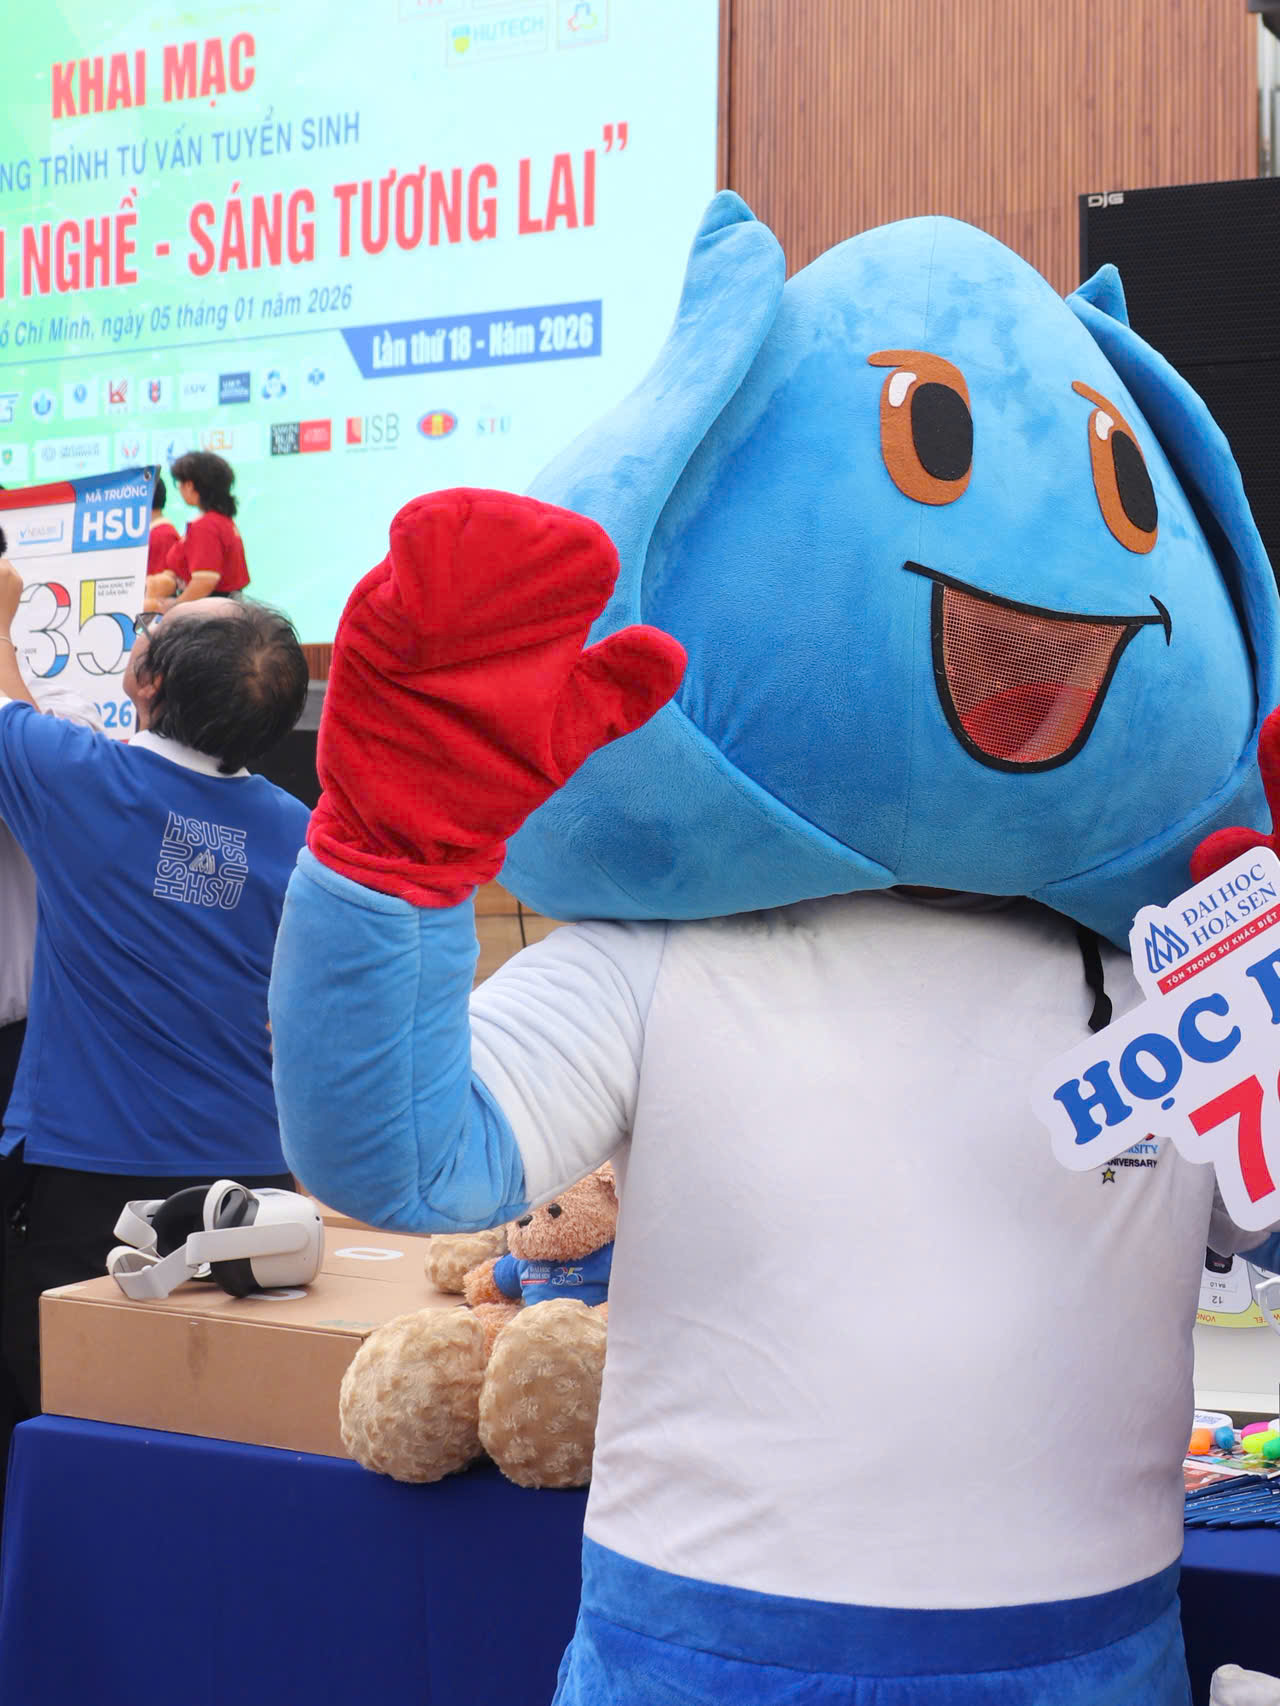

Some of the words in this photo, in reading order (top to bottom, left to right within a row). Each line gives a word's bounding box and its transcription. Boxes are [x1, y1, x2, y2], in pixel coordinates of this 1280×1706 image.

[52, 49, 146, 119] KHAI
[163, 31, 256, 108] MẠC
[40, 145, 108, 186] TRÌNH
[117, 137, 148, 176] TƯ
[156, 122, 203, 171] VẤN
[212, 105, 292, 164] TUYỂN
[301, 111, 360, 151] SINH
[22, 187, 138, 296] NGHỀ
[188, 181, 316, 277] SÁNG
[333, 164, 498, 257] TƯƠNG
[103, 312, 144, 342] ngày
[151, 306, 171, 331] 05
[177, 302, 228, 331] tháng
[234, 296, 255, 322] 01
[261, 291, 302, 319] năm
[308, 284, 352, 314] 2026
[448, 325, 472, 361] 18
[489, 320, 536, 357] Năm
[540, 312, 593, 352] 2026
[366, 412, 400, 445] ISB
[82, 506, 147, 543] HSU
[164, 811, 221, 850] HSU
[184, 873, 243, 910] HSU
[1192, 909, 1239, 946] HOA
[1237, 882, 1277, 917] SEN
[1166, 971, 1185, 987] TÔN
[1186, 953, 1217, 974] TRỌNG
[1217, 941, 1231, 954] SỰ
[1231, 926, 1256, 945] KHÁC
[1256, 911, 1279, 929] BIỆT
[1054, 992, 1241, 1145] HỌC
[1211, 1295, 1222, 1304] 12
